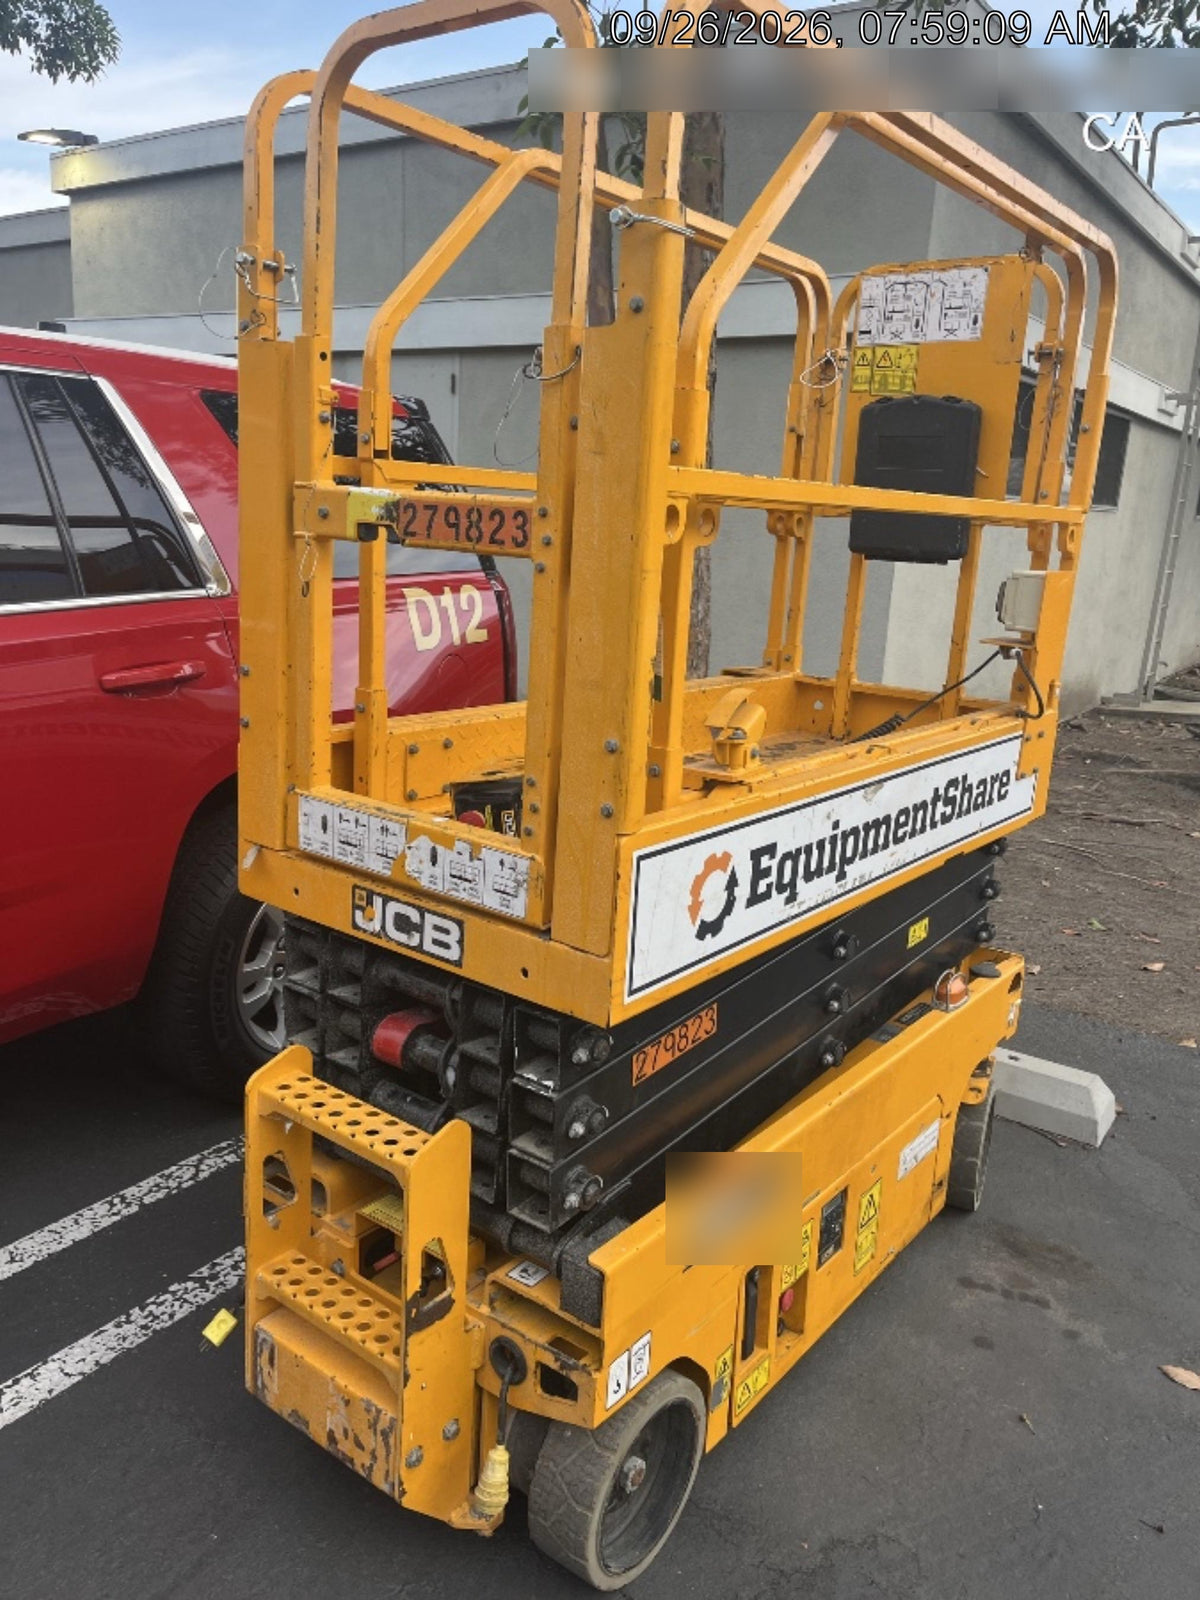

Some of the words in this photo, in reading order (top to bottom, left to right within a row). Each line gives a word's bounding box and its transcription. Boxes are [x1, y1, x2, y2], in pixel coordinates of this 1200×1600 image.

[402, 502, 529, 548] 279823
[401, 584, 488, 651] D12
[744, 768, 1011, 910] EquipmentShare
[353, 890, 462, 961] JCB
[634, 1006, 716, 1082] 279823
